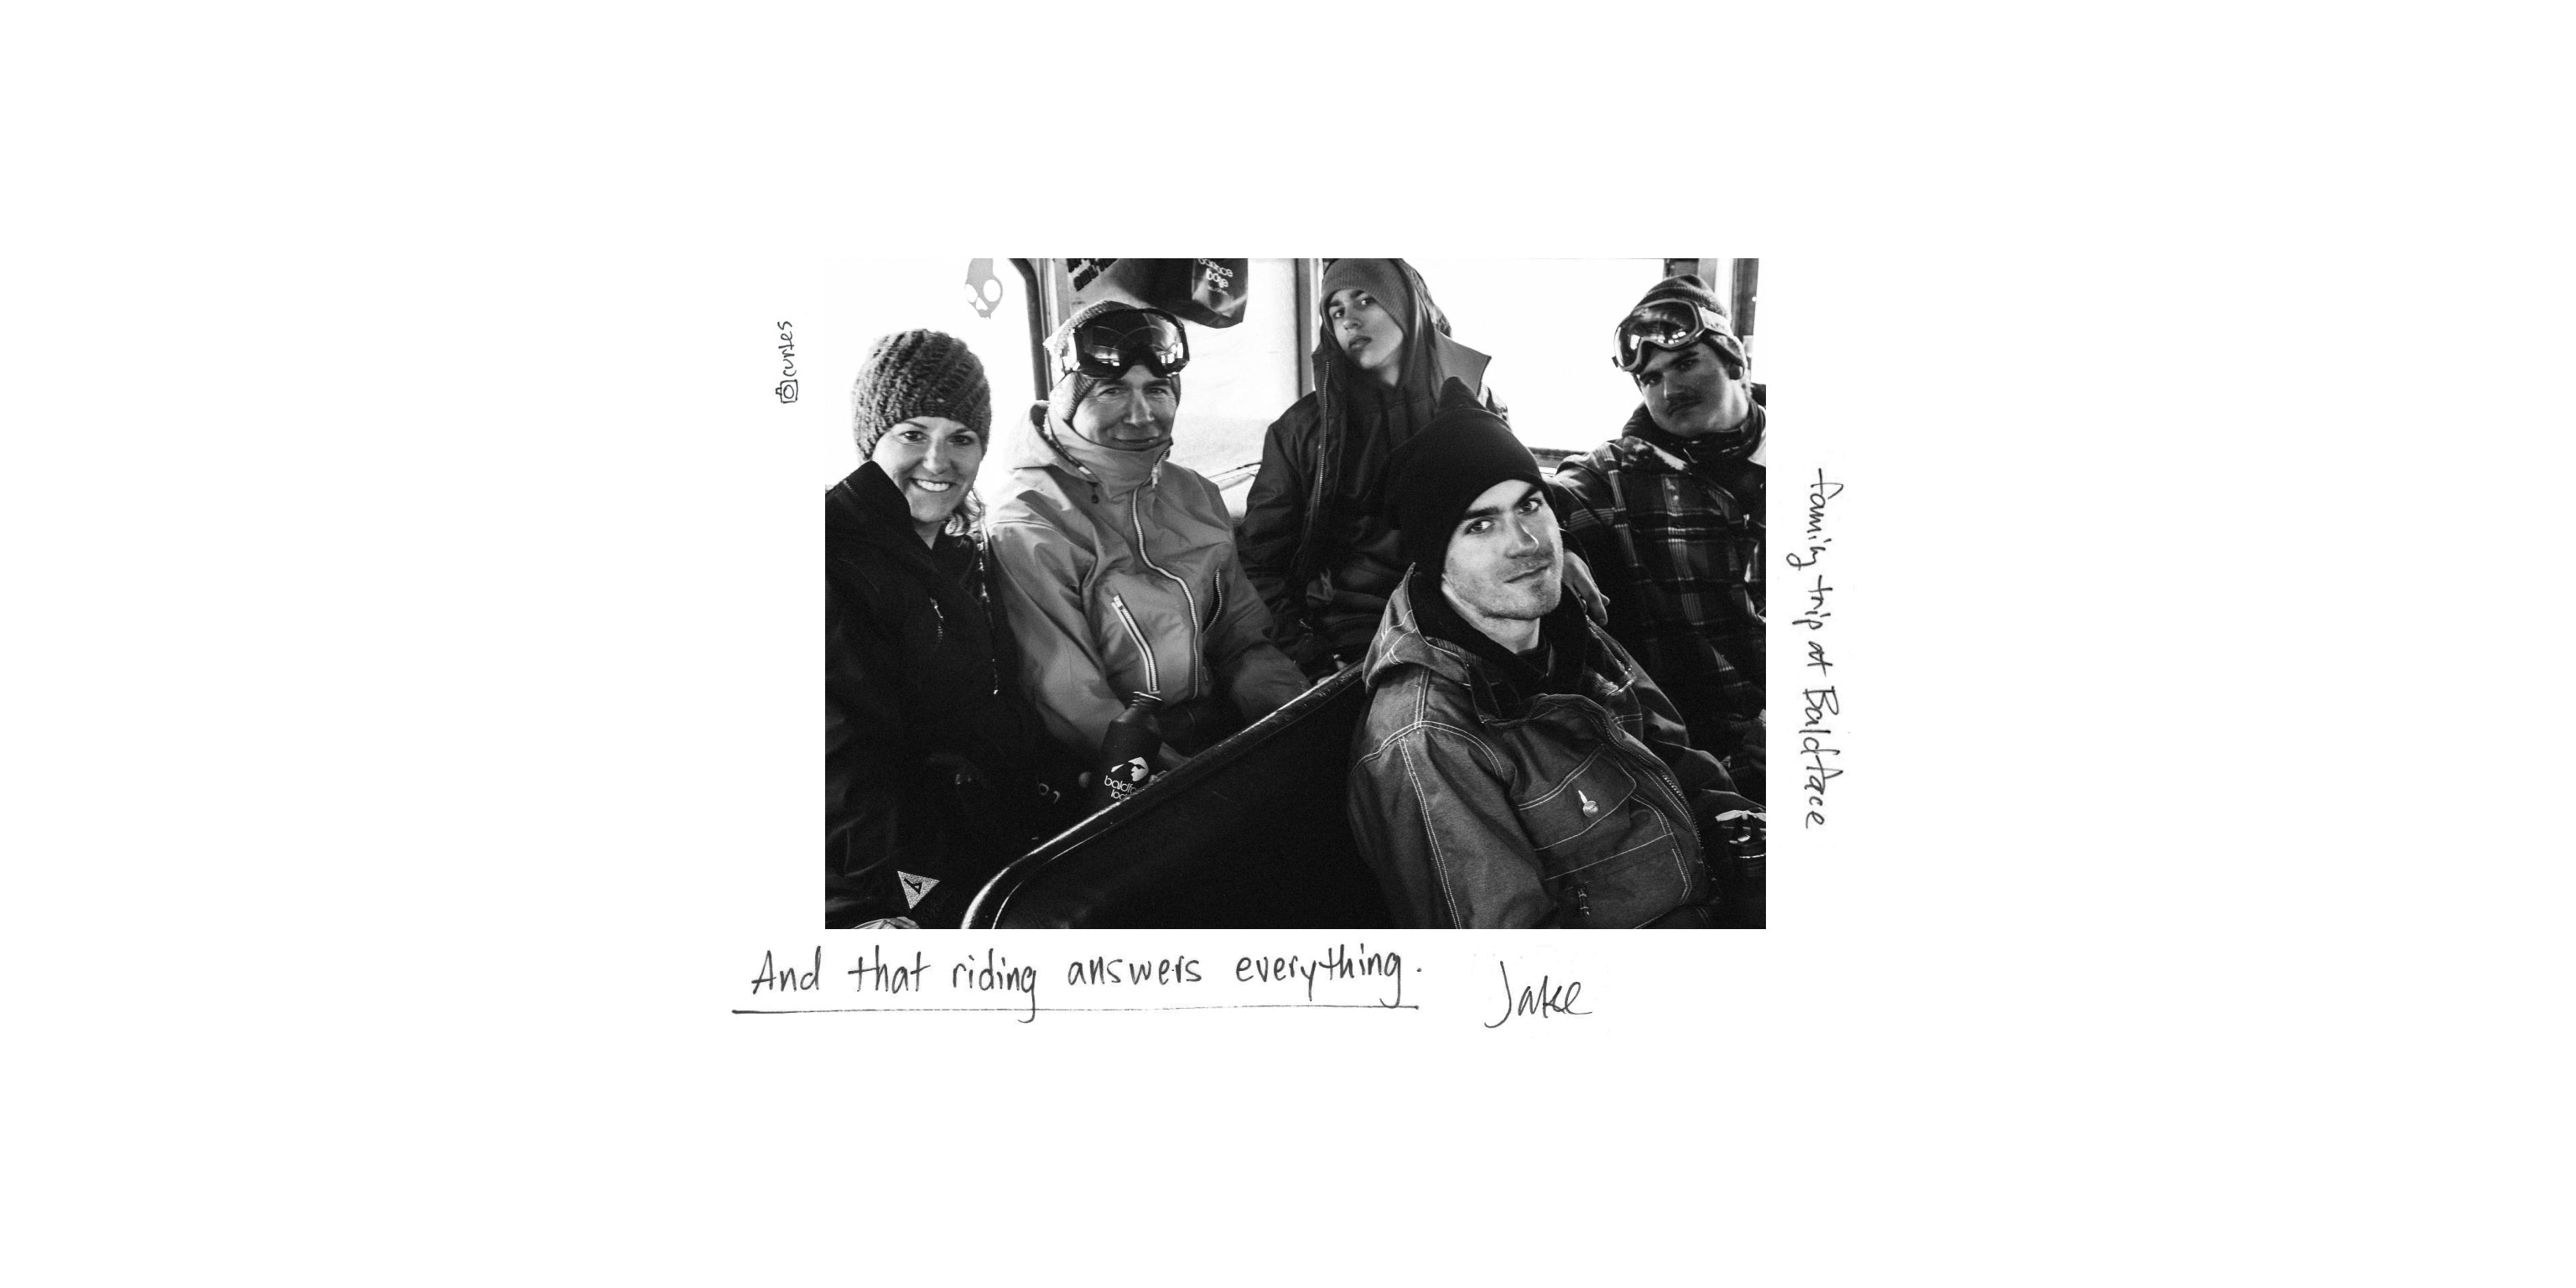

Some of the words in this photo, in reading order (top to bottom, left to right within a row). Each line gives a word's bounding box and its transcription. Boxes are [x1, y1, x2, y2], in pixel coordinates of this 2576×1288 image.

[1791, 574, 1834, 631] trip
[1806, 641, 1834, 676] at
[1798, 685, 1844, 829] Baldface
[750, 945, 822, 995] And
[847, 944, 932, 995] that
[952, 948, 1040, 1024] riding
[1067, 955, 1203, 986] answers
[1235, 943, 1422, 1010] everything.
[1483, 960, 1593, 1029] Jake
